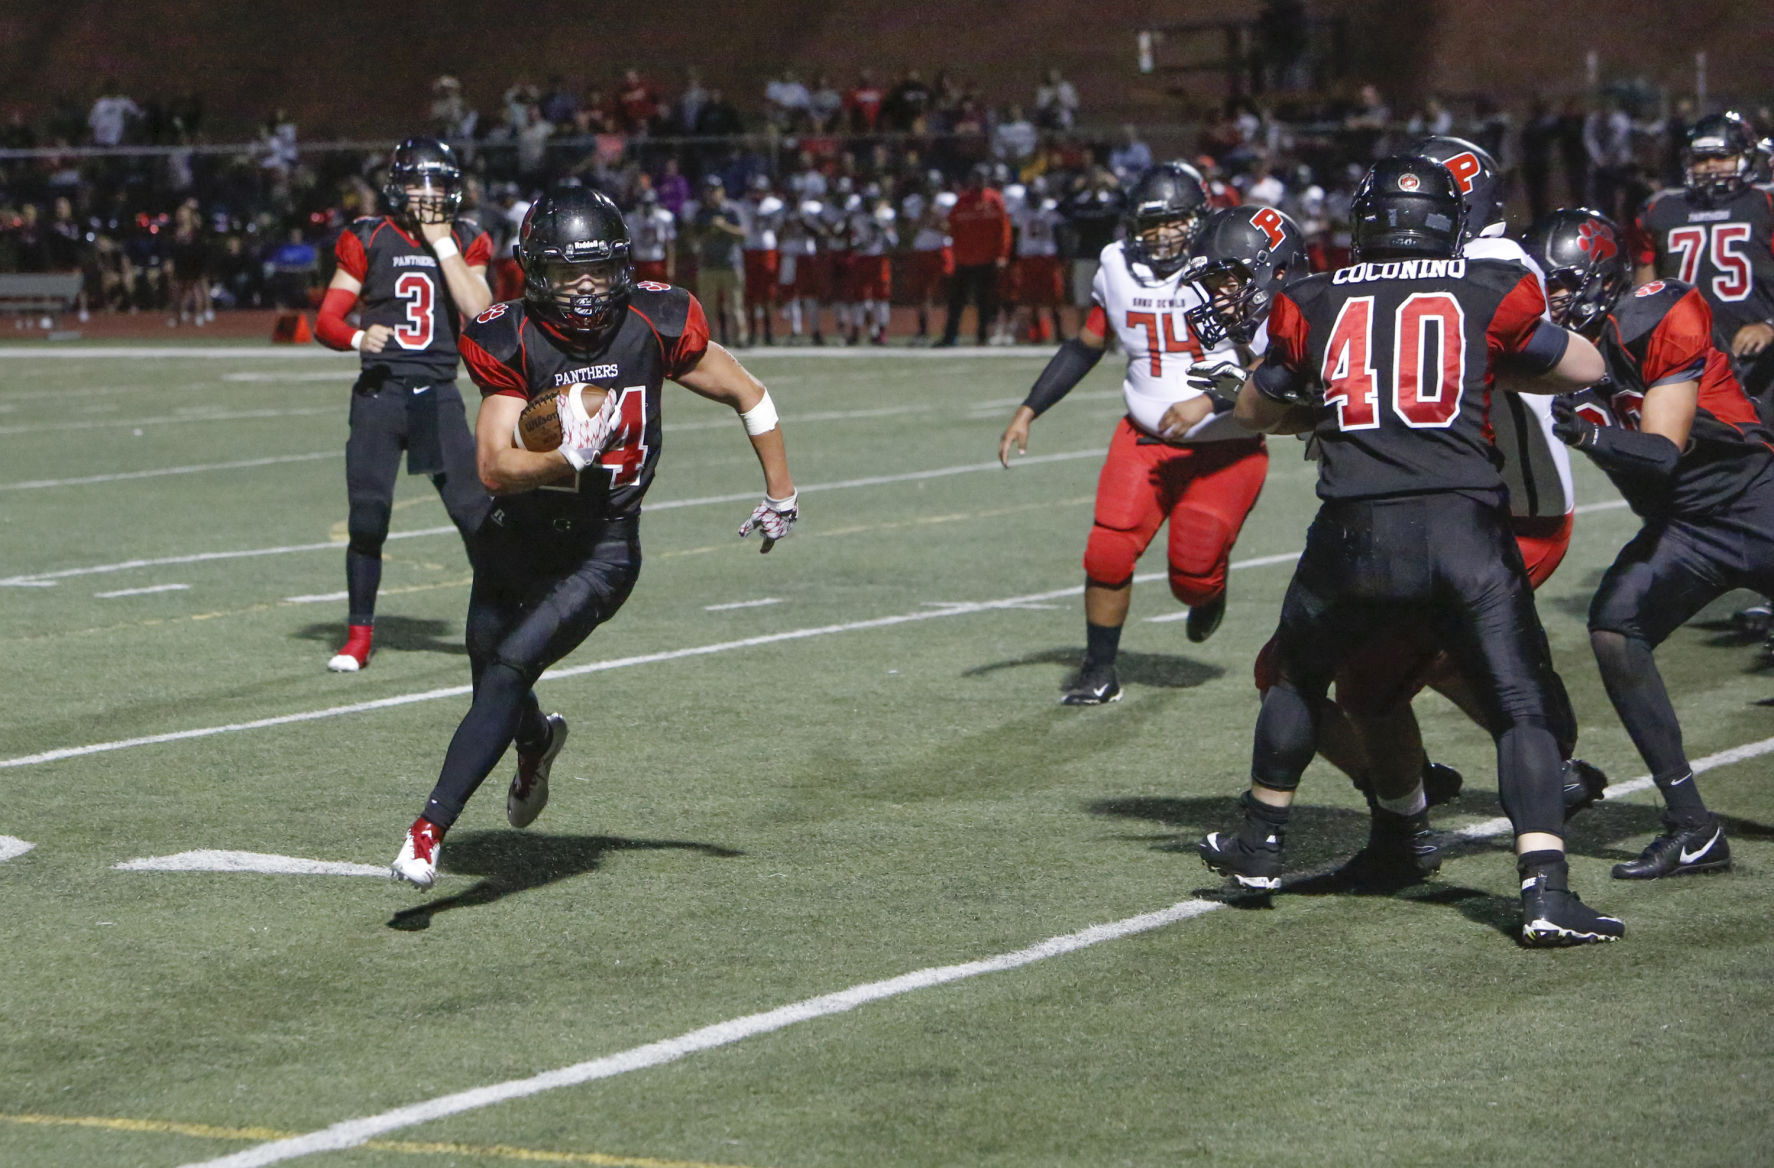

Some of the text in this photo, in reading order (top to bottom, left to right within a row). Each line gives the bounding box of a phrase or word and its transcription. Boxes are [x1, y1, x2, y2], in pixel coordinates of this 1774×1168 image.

[1441, 151, 1481, 195] P
[574, 240, 598, 250] Riddell
[1250, 207, 1287, 253] P
[1332, 259, 1466, 285] COCONINO
[1668, 223, 1752, 302] 75
[395, 272, 434, 350] 3
[1126, 311, 1205, 378] 74
[1321, 292, 1467, 432] 40
[554, 364, 618, 386] PANTHERS
[525, 413, 557, 432] Wilson
